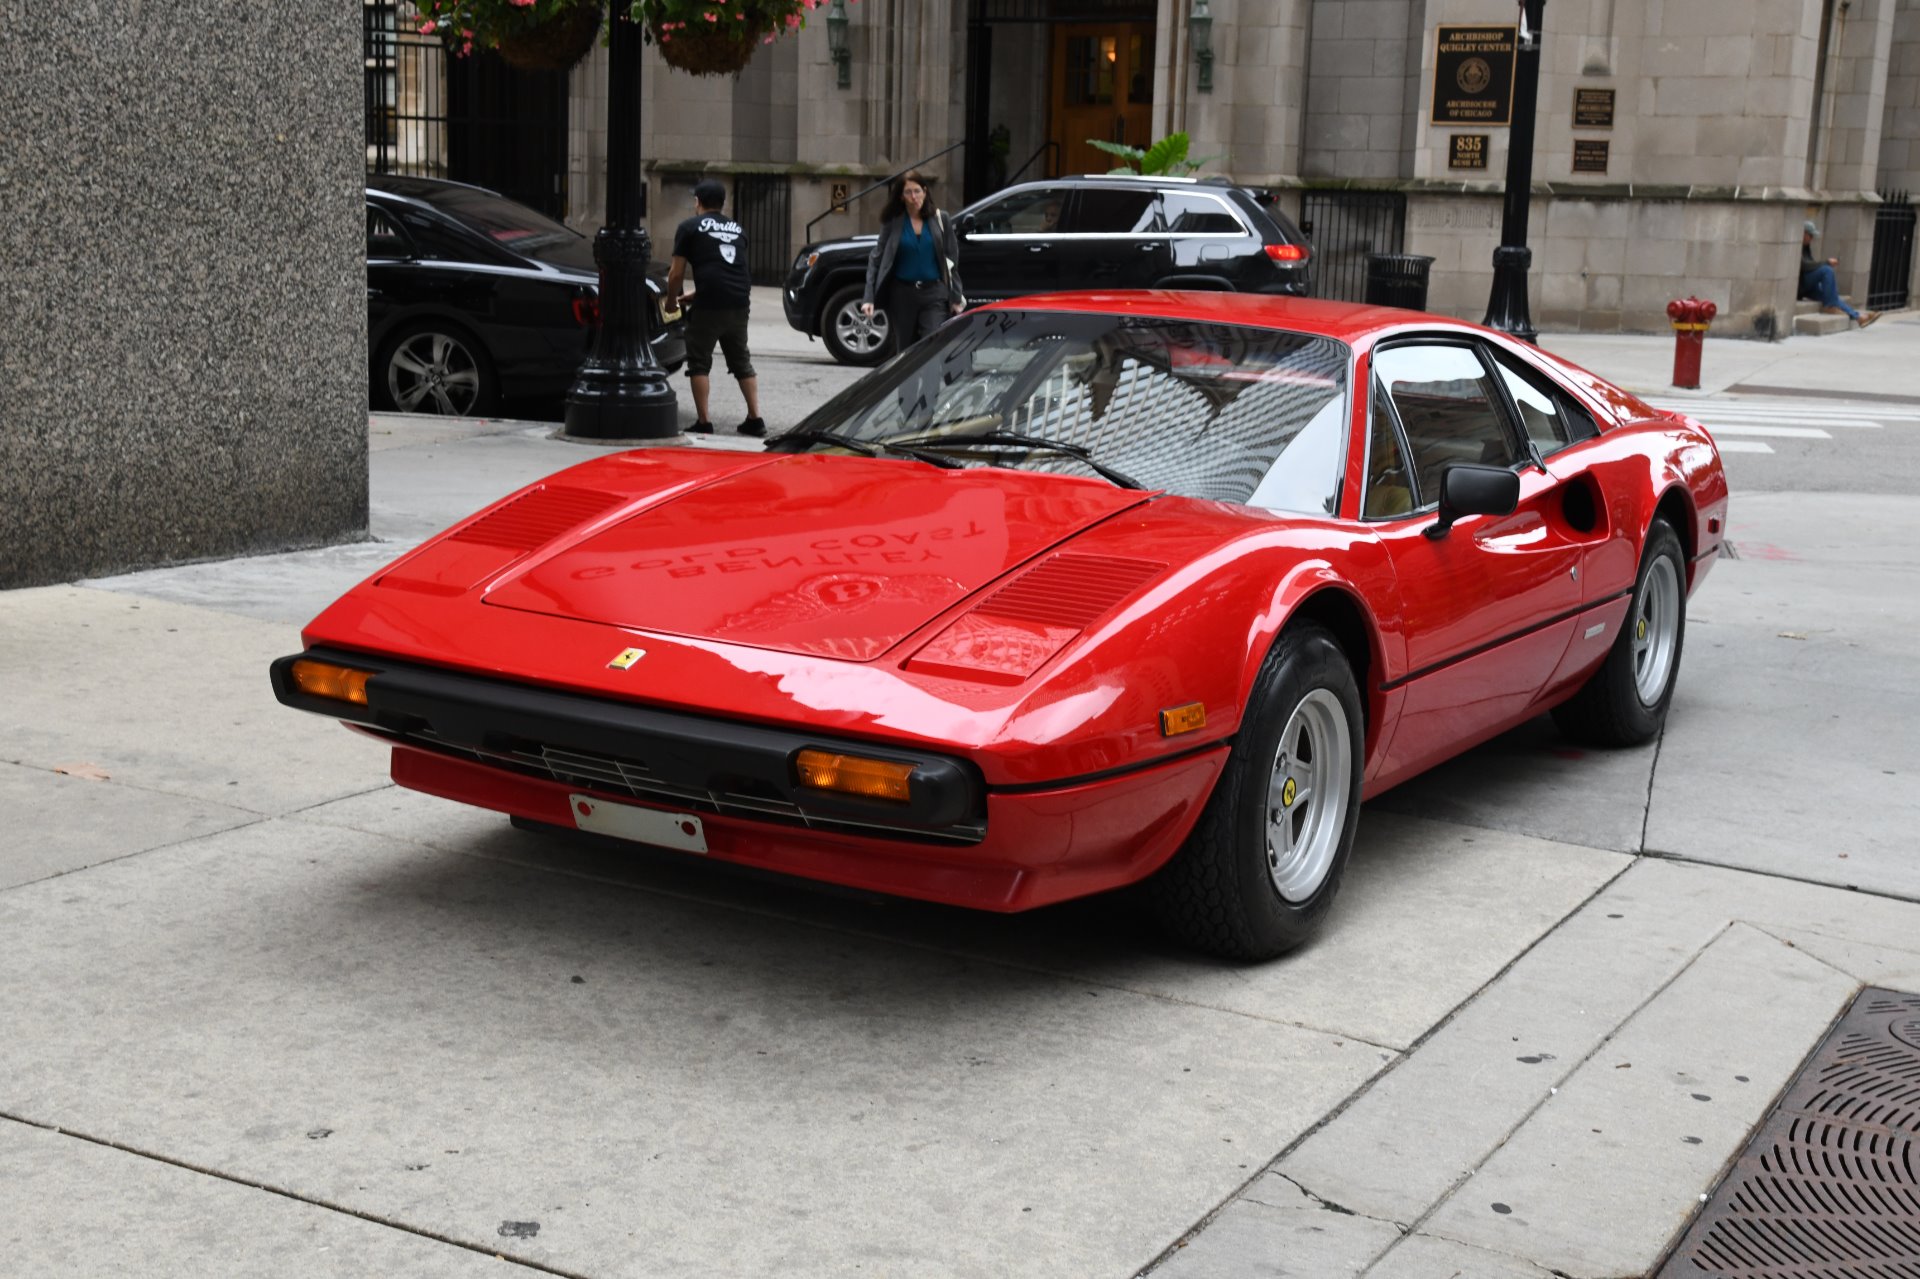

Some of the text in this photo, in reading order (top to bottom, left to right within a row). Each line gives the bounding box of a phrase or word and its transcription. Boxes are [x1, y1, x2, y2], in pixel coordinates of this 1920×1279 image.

[1449, 33, 1504, 41] ARCHBISHOP
[1440, 43, 1512, 52] QUIGLEY CENTER
[1446, 100, 1497, 108] ARCHDIOCESE
[1456, 137, 1482, 151] 835
[698, 218, 742, 234] Perillo
